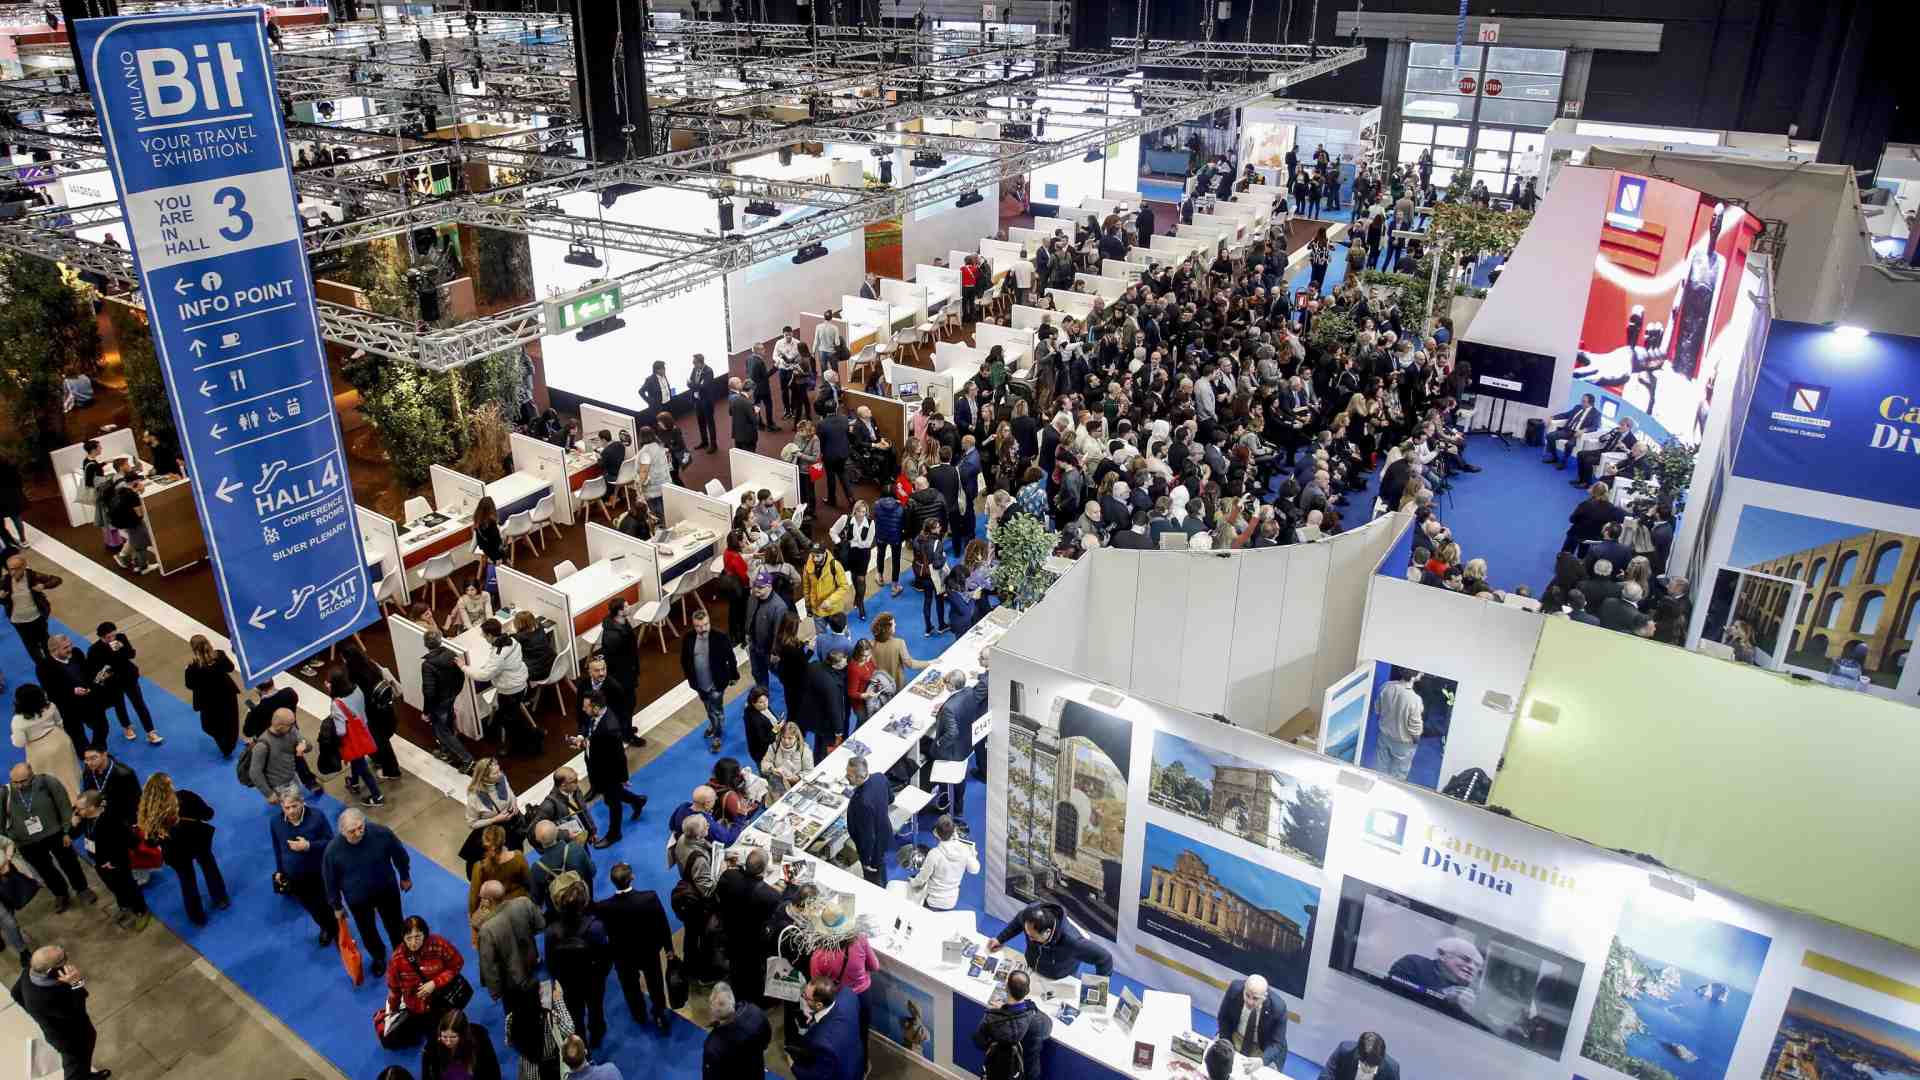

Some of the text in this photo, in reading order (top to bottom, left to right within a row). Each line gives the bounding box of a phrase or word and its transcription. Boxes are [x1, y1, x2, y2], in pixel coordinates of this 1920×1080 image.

[1482, 30, 1496, 41] 10
[119, 50, 147, 121] MILANO
[135, 42, 244, 118] Bit
[140, 125, 257, 154] YOUR TRAVEL
[152, 143, 254, 168] EXHIBITION.
[153, 193, 191, 212] YOU
[159, 210, 195, 228] ARE
[213, 186, 254, 242] 3
[161, 228, 178, 242] IN
[165, 237, 210, 257] HALL
[179, 279, 295, 321] INFO POINT
[255, 458, 339, 516] HALL 4
[283, 494, 344, 528] CONFERENCE
[315, 505, 345, 527] ROOMS
[272, 541, 308, 562] SILVER
[308, 521, 348, 549] PLENARY
[317, 575, 358, 612] EXIT
[319, 595, 357, 620] BALCONY
[1421, 846, 1514, 896] Divina
[1423, 823, 1577, 891] Campania
